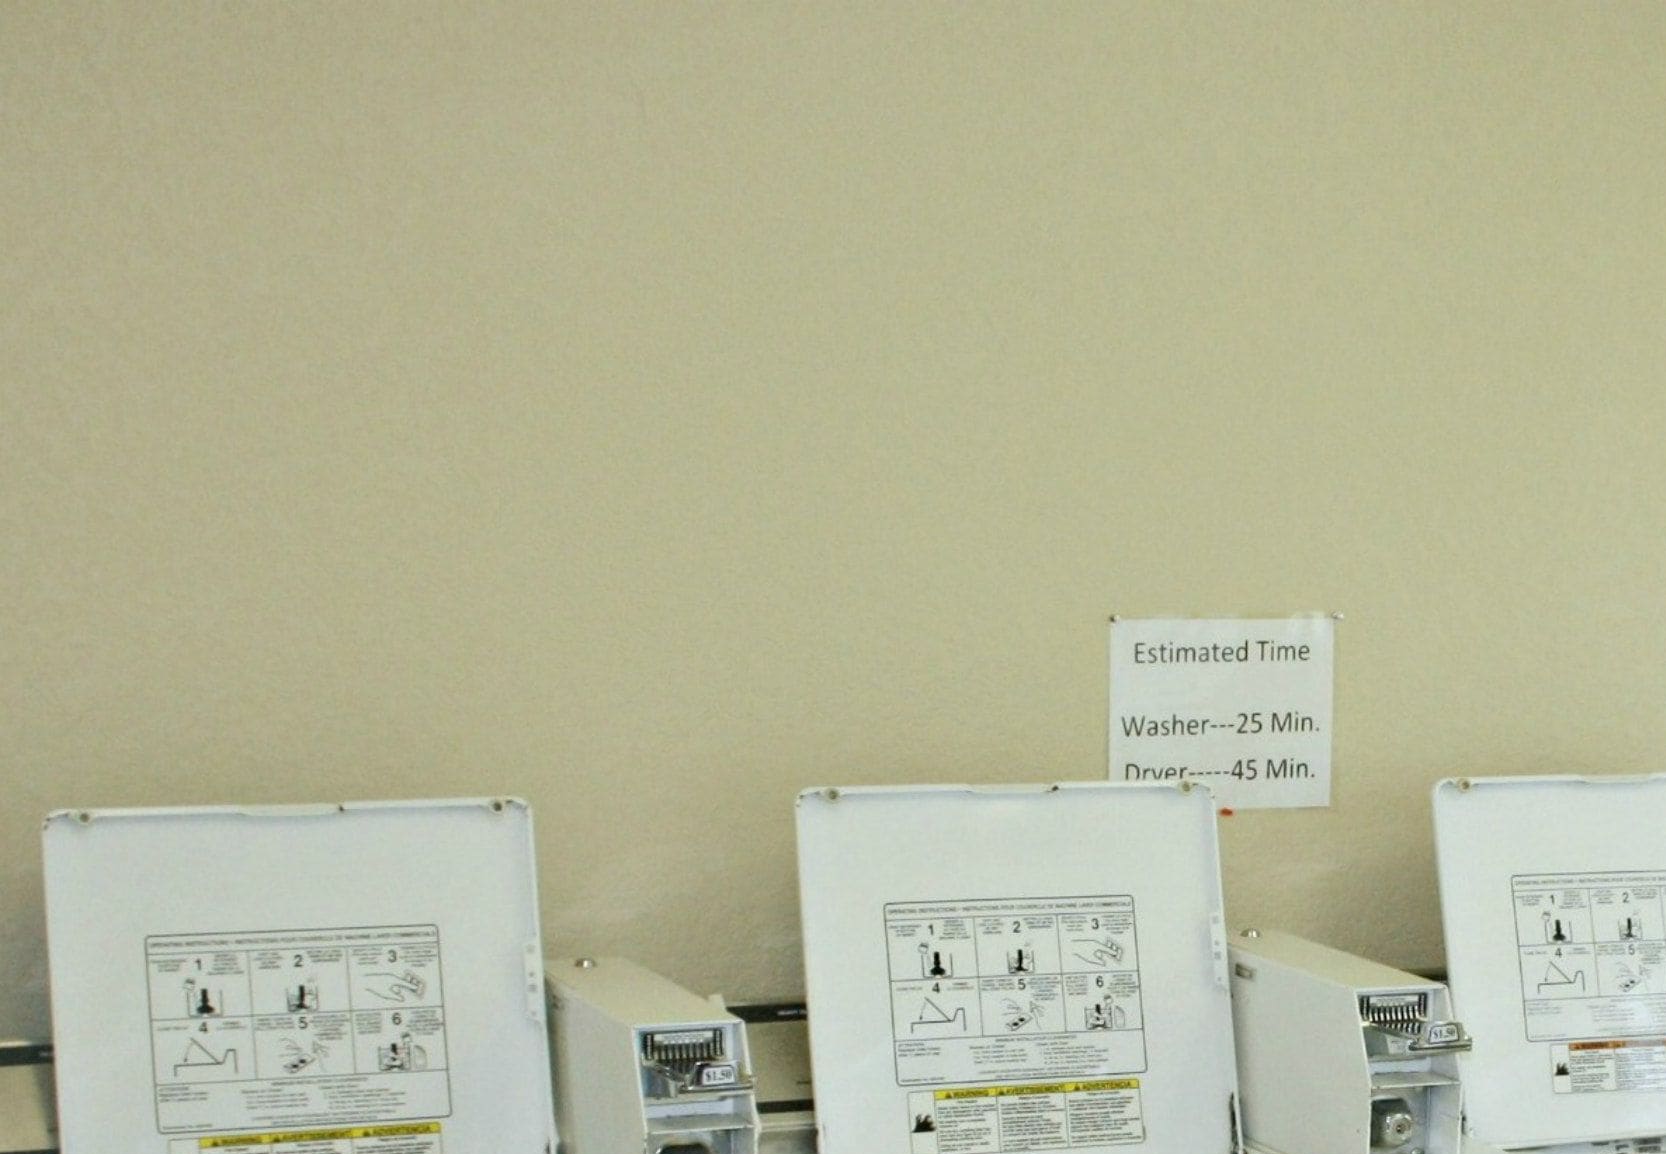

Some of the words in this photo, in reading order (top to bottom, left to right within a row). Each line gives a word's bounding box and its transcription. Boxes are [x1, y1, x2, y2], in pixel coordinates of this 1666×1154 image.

[1134, 640, 1249, 664] Estimated
[1256, 640, 1311, 662] Time
[1271, 711, 1320, 734] Min.
[1266, 758, 1315, 779] Min.
[1622, 891, 1630, 904] 2
[927, 924, 934, 936] 1
[1012, 920, 1021, 934] 2
[1091, 917, 1100, 930] 3
[387, 950, 398, 963] 3
[1554, 947, 1563, 958] 4
[195, 958, 202, 971] 1
[293, 954, 304, 968] 2
[932, 982, 941, 994] 4
[1017, 978, 1027, 991] 5
[1095, 975, 1104, 988] 6
[298, 1016, 308, 1030] 5
[391, 1012, 402, 1026] 6
[199, 1021, 208, 1034] 4
[706, 1070, 732, 1082] $1.50
